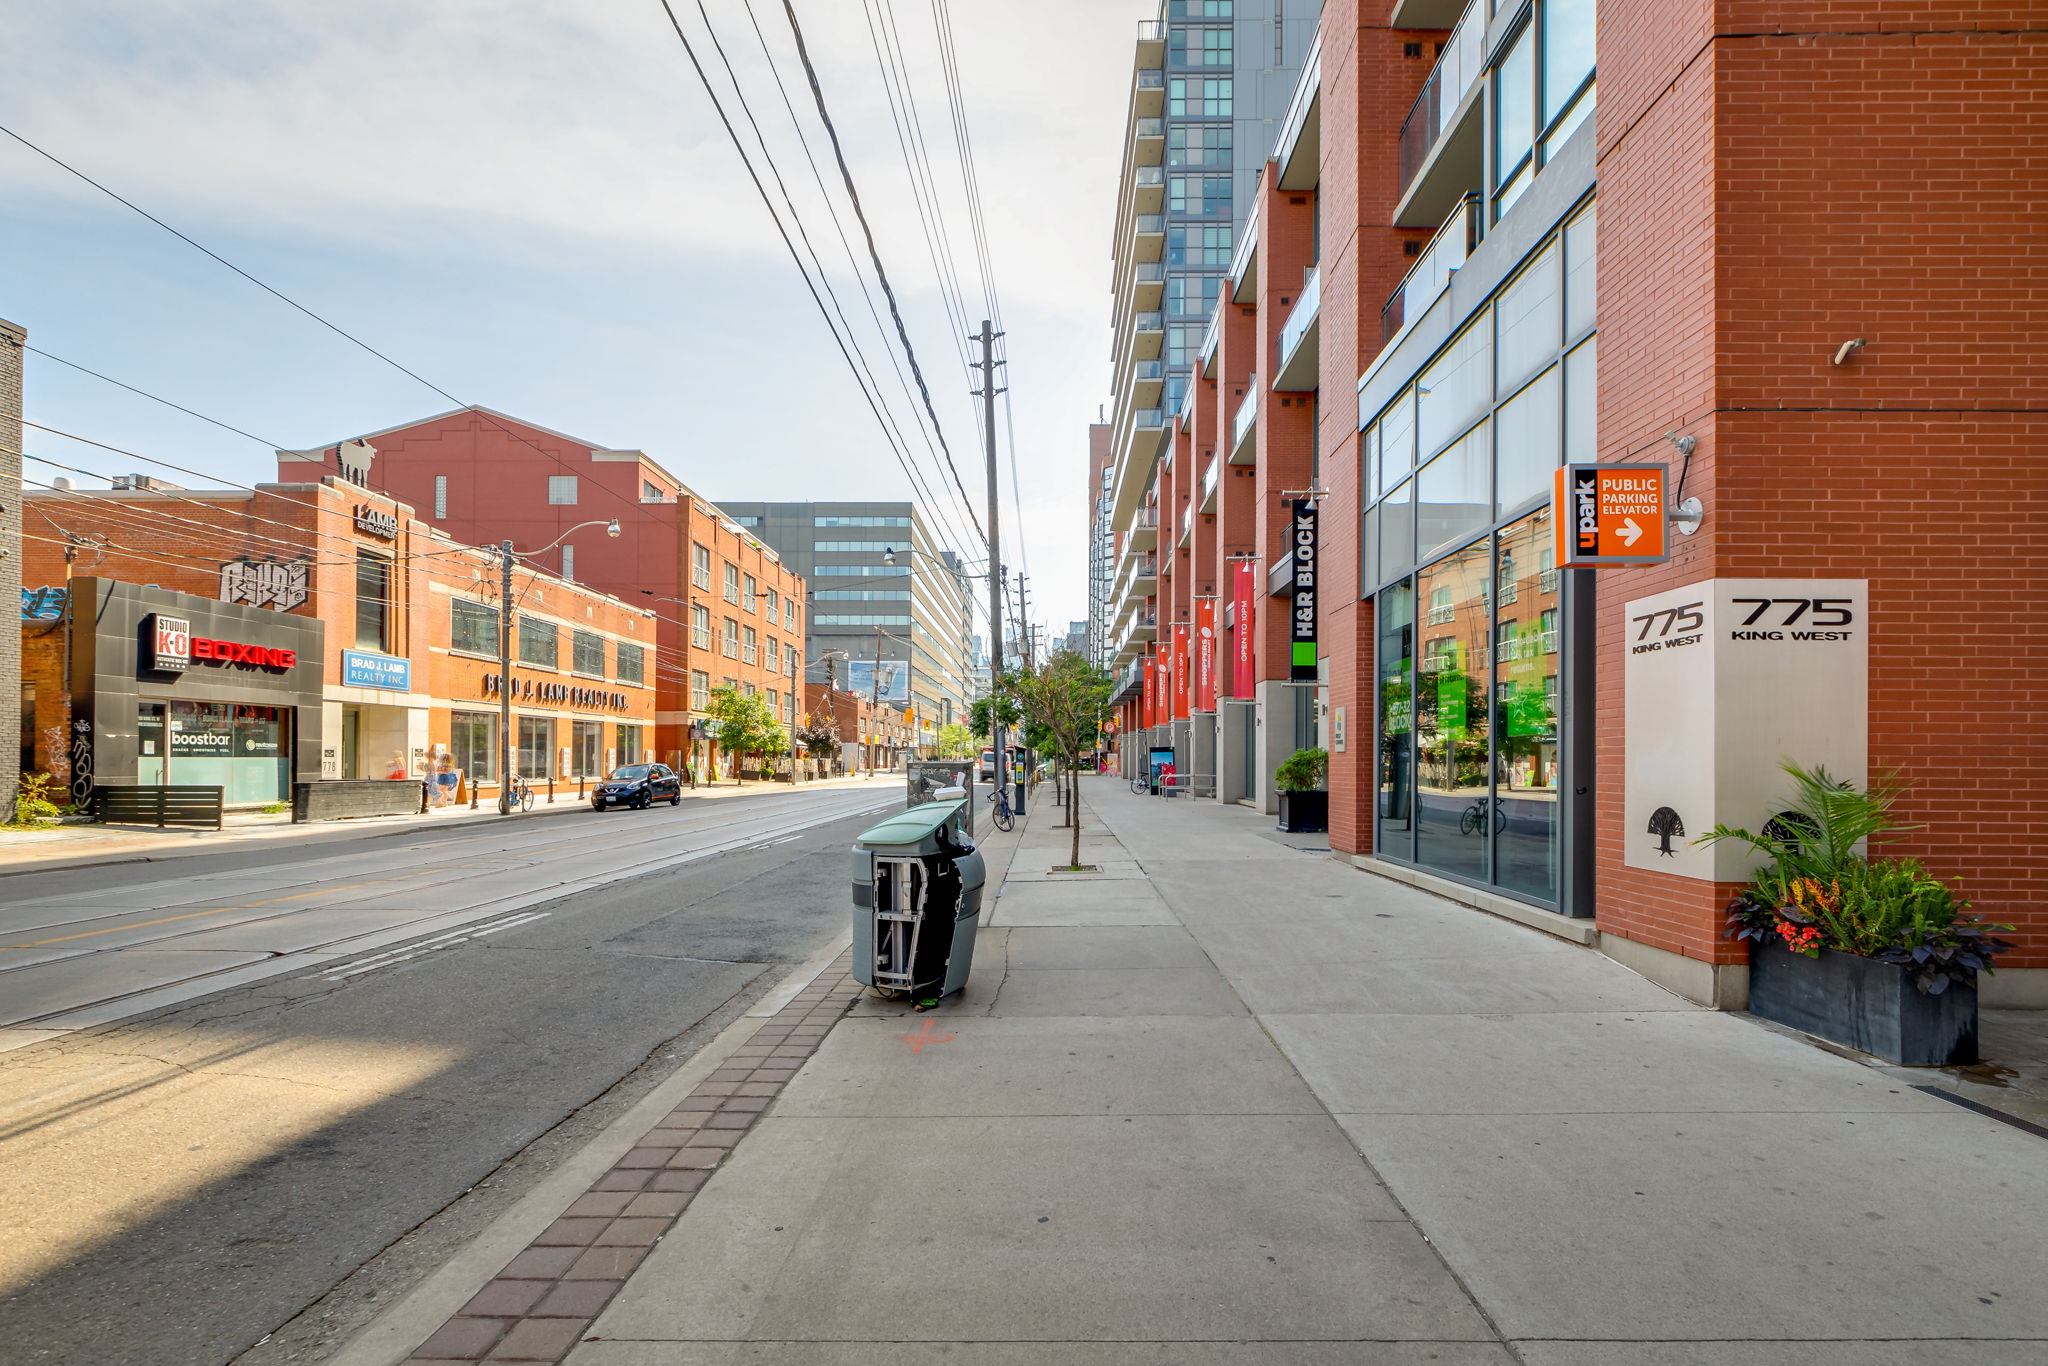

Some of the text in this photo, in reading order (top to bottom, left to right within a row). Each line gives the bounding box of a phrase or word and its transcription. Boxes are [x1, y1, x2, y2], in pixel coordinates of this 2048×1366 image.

[1602, 479, 1657, 491] PUBLIC
[1603, 494, 1658, 503] PARKING
[1575, 479, 1598, 547] upark
[1603, 506, 1657, 514] ELEVATOR
[1297, 515, 1313, 636] H&R BLOCK
[1732, 599, 1852, 626] 775
[159, 618, 187, 633] STUDIO
[1241, 623, 1247, 635] TO
[1633, 601, 1703, 641] 775
[158, 631, 187, 656] K-O
[1732, 631, 1852, 641] KING WEST
[192, 637, 296, 668] BOXING
[1633, 634, 1703, 655] KING WEST
[351, 658, 405, 674] BRAD J. LAMB
[351, 670, 385, 682] REALTY
[486, 673, 520, 694] BRD
[540, 682, 569, 700] LAMB
[574, 687, 609, 705] REALTY
[171, 731, 230, 746] boostbar
